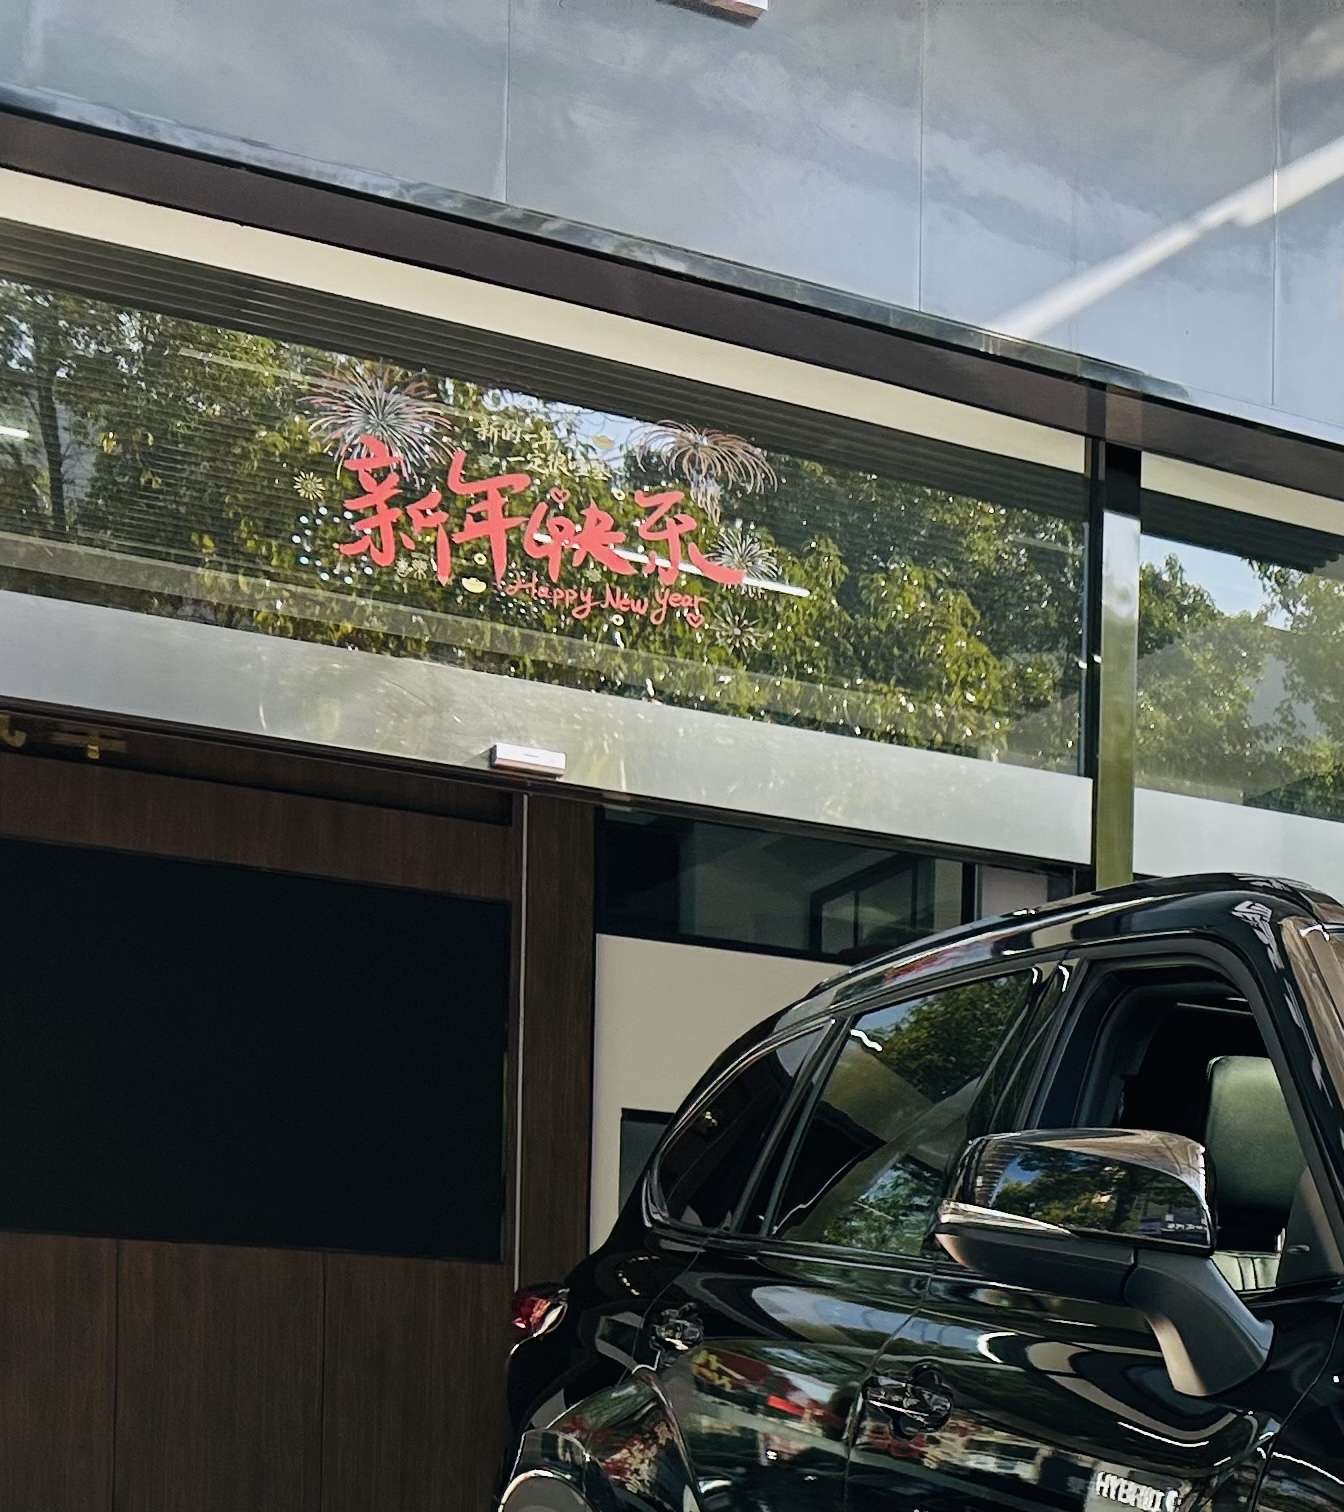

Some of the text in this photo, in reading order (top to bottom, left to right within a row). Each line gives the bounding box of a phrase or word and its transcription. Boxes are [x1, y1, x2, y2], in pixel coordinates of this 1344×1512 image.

[474, 416, 559, 451] 新的一年
[338, 434, 745, 586] 新年快乐
[505, 570, 598, 620] Happy
[601, 582, 648, 616] New
